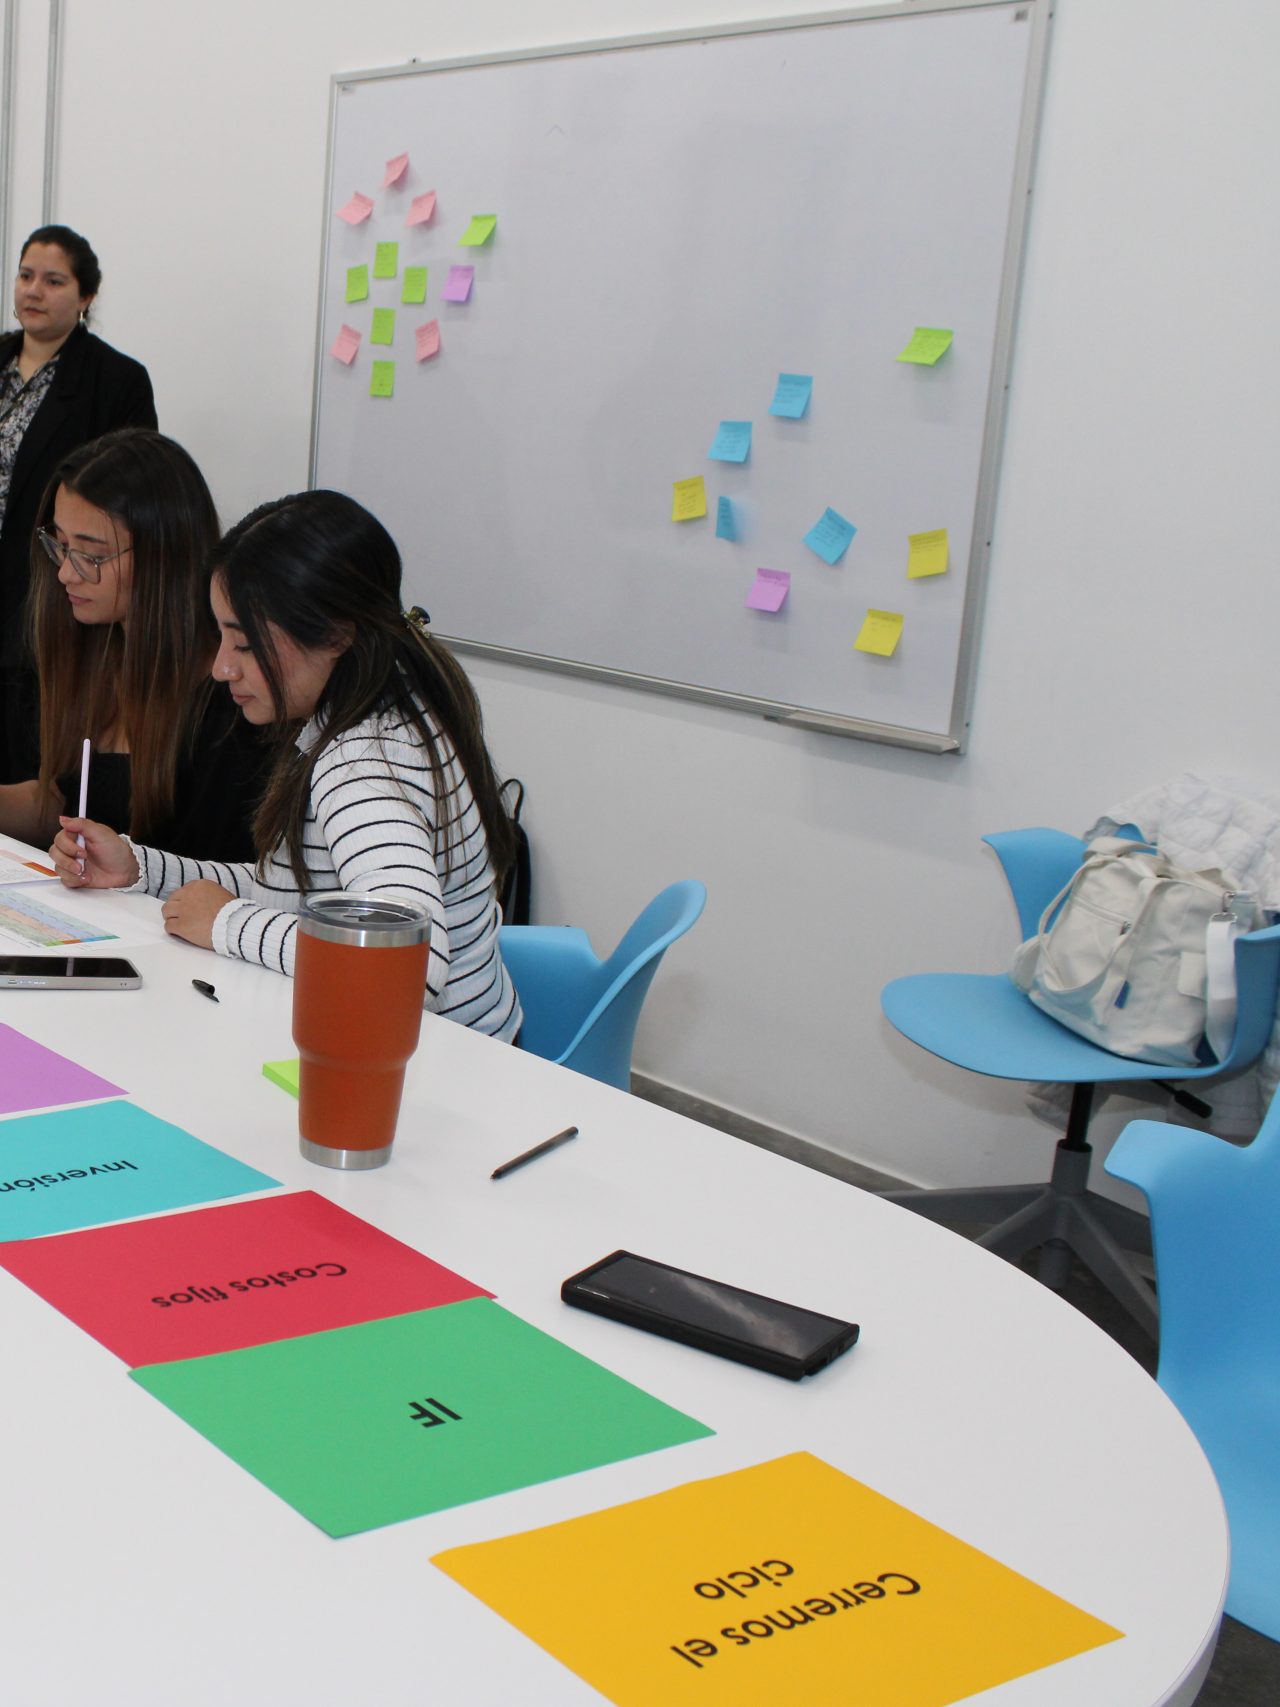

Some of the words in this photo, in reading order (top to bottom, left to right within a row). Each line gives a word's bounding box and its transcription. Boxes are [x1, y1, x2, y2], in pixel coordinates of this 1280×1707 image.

[228, 1262, 348, 1292] Costos
[151, 1285, 229, 1308] fijos
[408, 1397, 463, 1428] IF
[692, 1557, 796, 1602] ciclo
[724, 1571, 923, 1649] Cerremos
[669, 1634, 719, 1670] el
